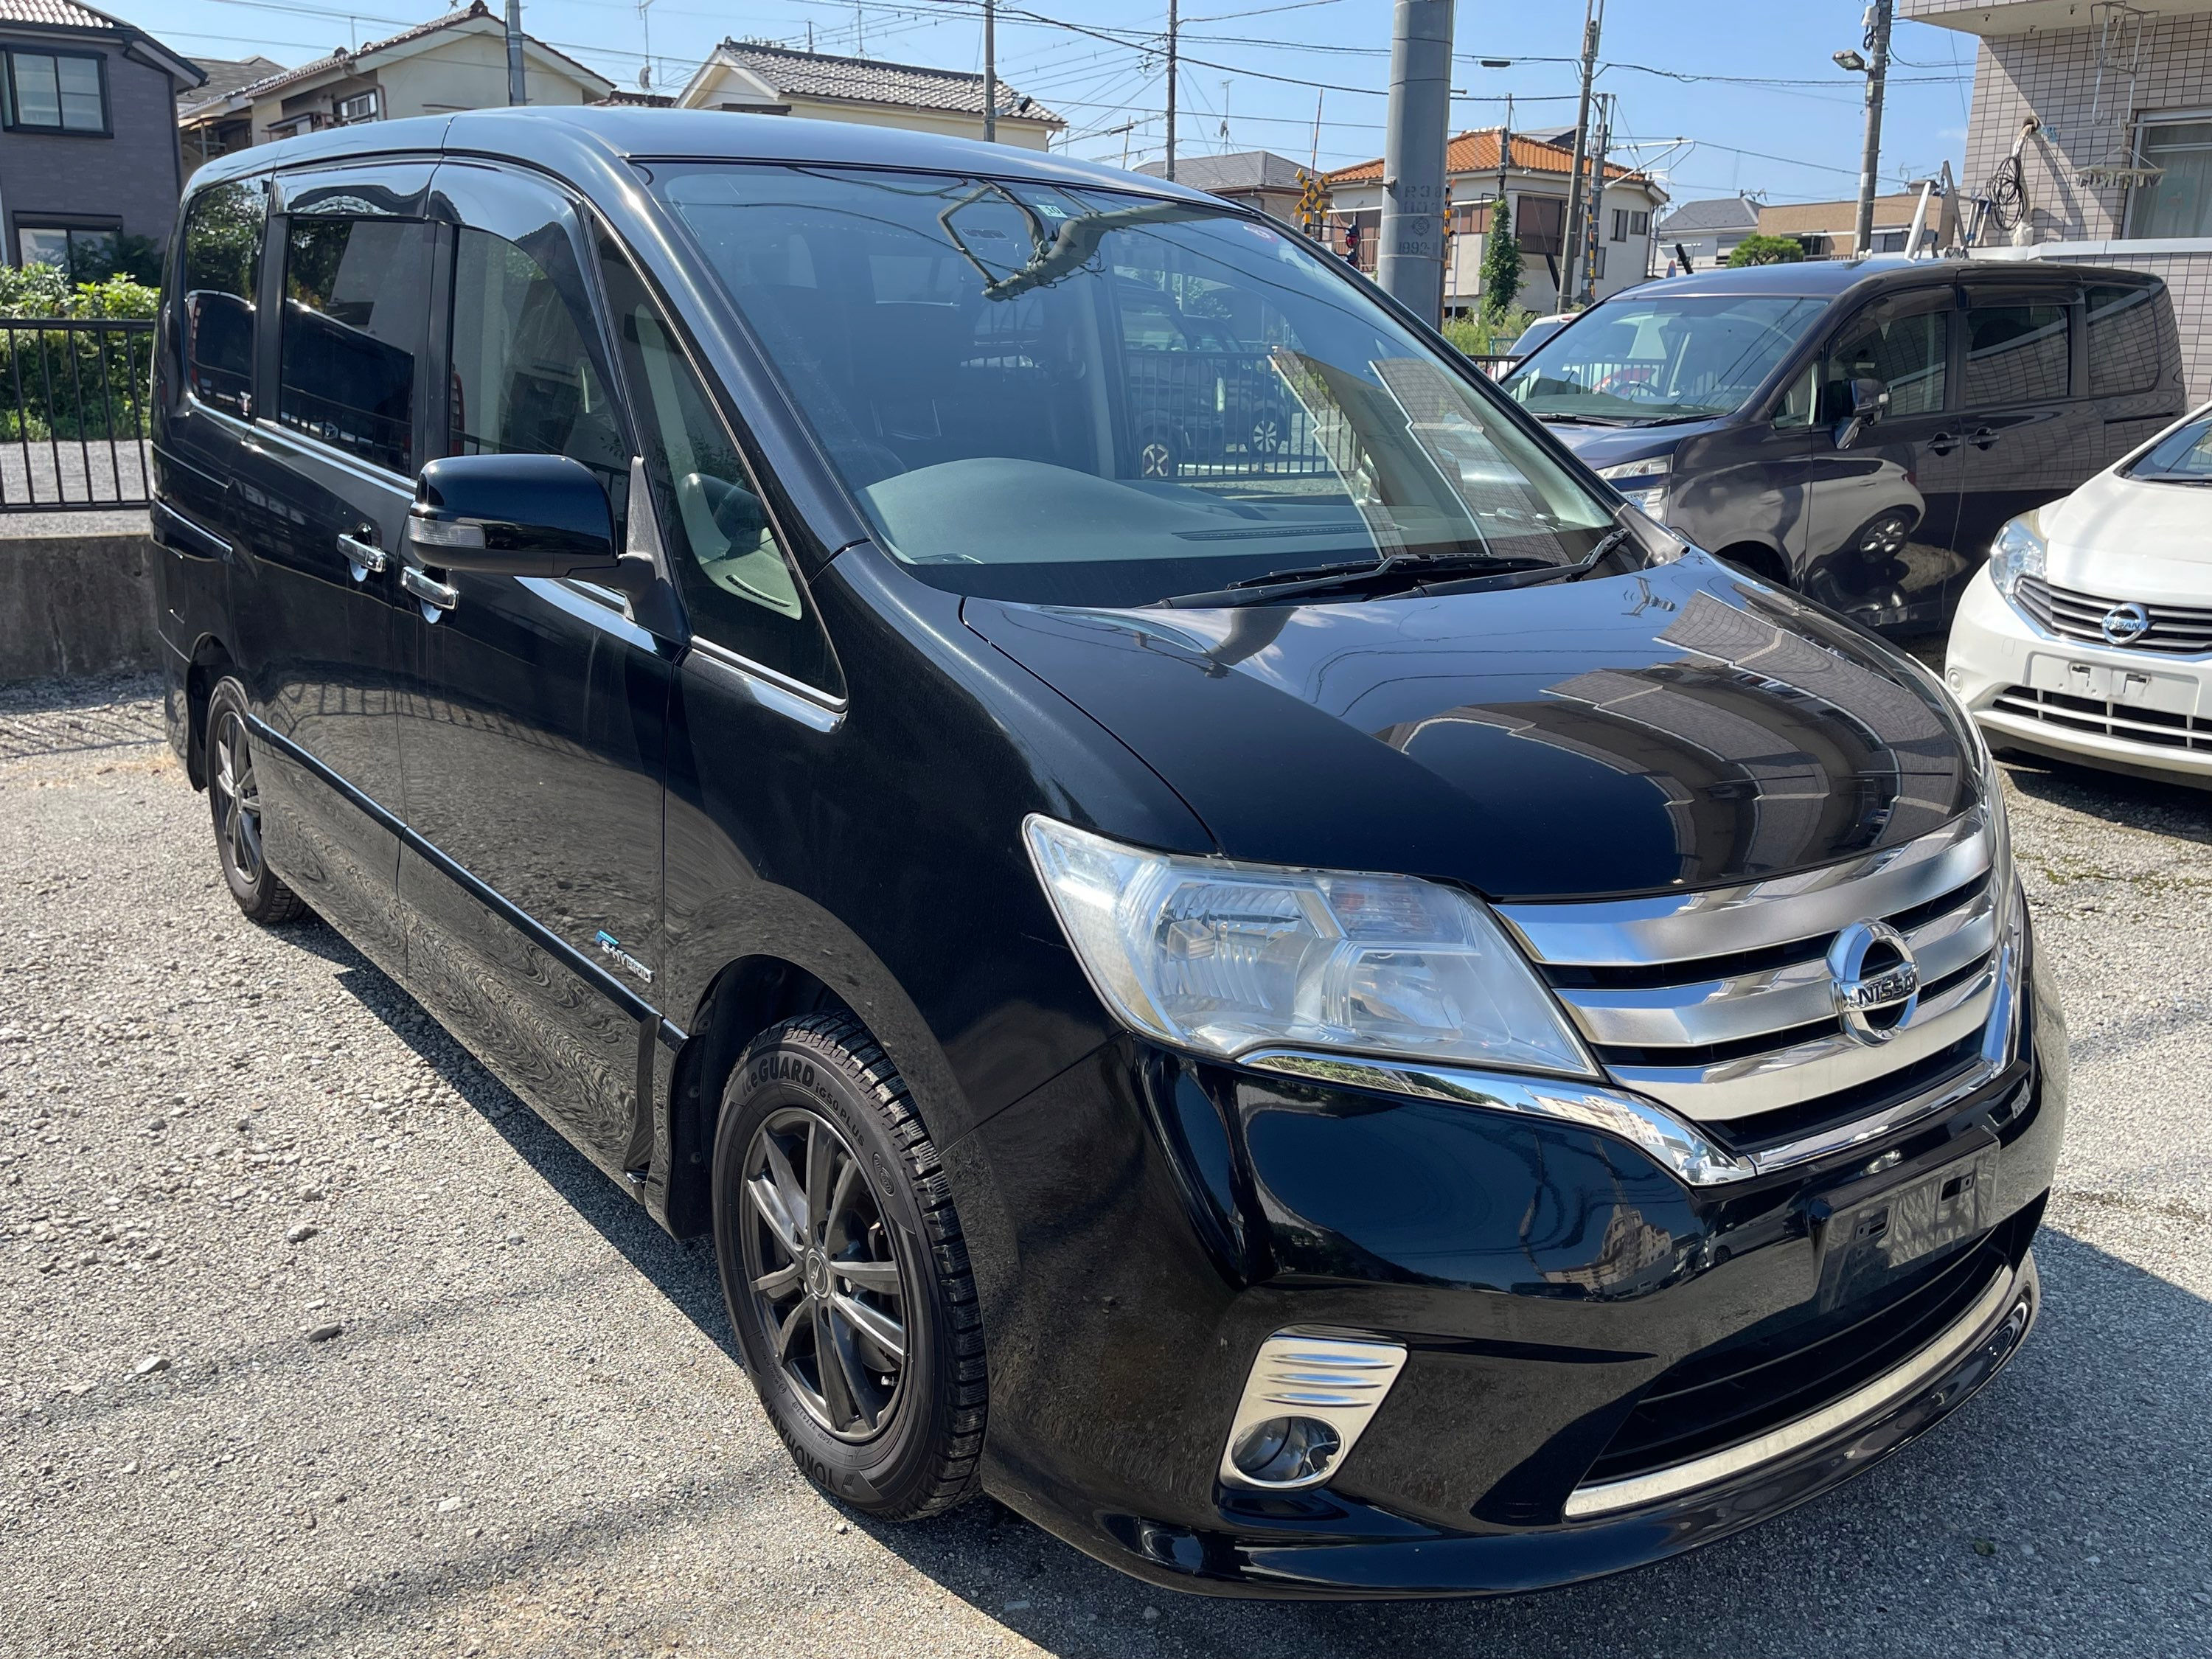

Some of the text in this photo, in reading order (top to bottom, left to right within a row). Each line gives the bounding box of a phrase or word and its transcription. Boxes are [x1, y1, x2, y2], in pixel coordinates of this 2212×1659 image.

[815, 1082, 840, 1112] iG50
[839, 1110, 866, 1147] PLUS
[760, 1386, 838, 1492] YOKOHAMA
